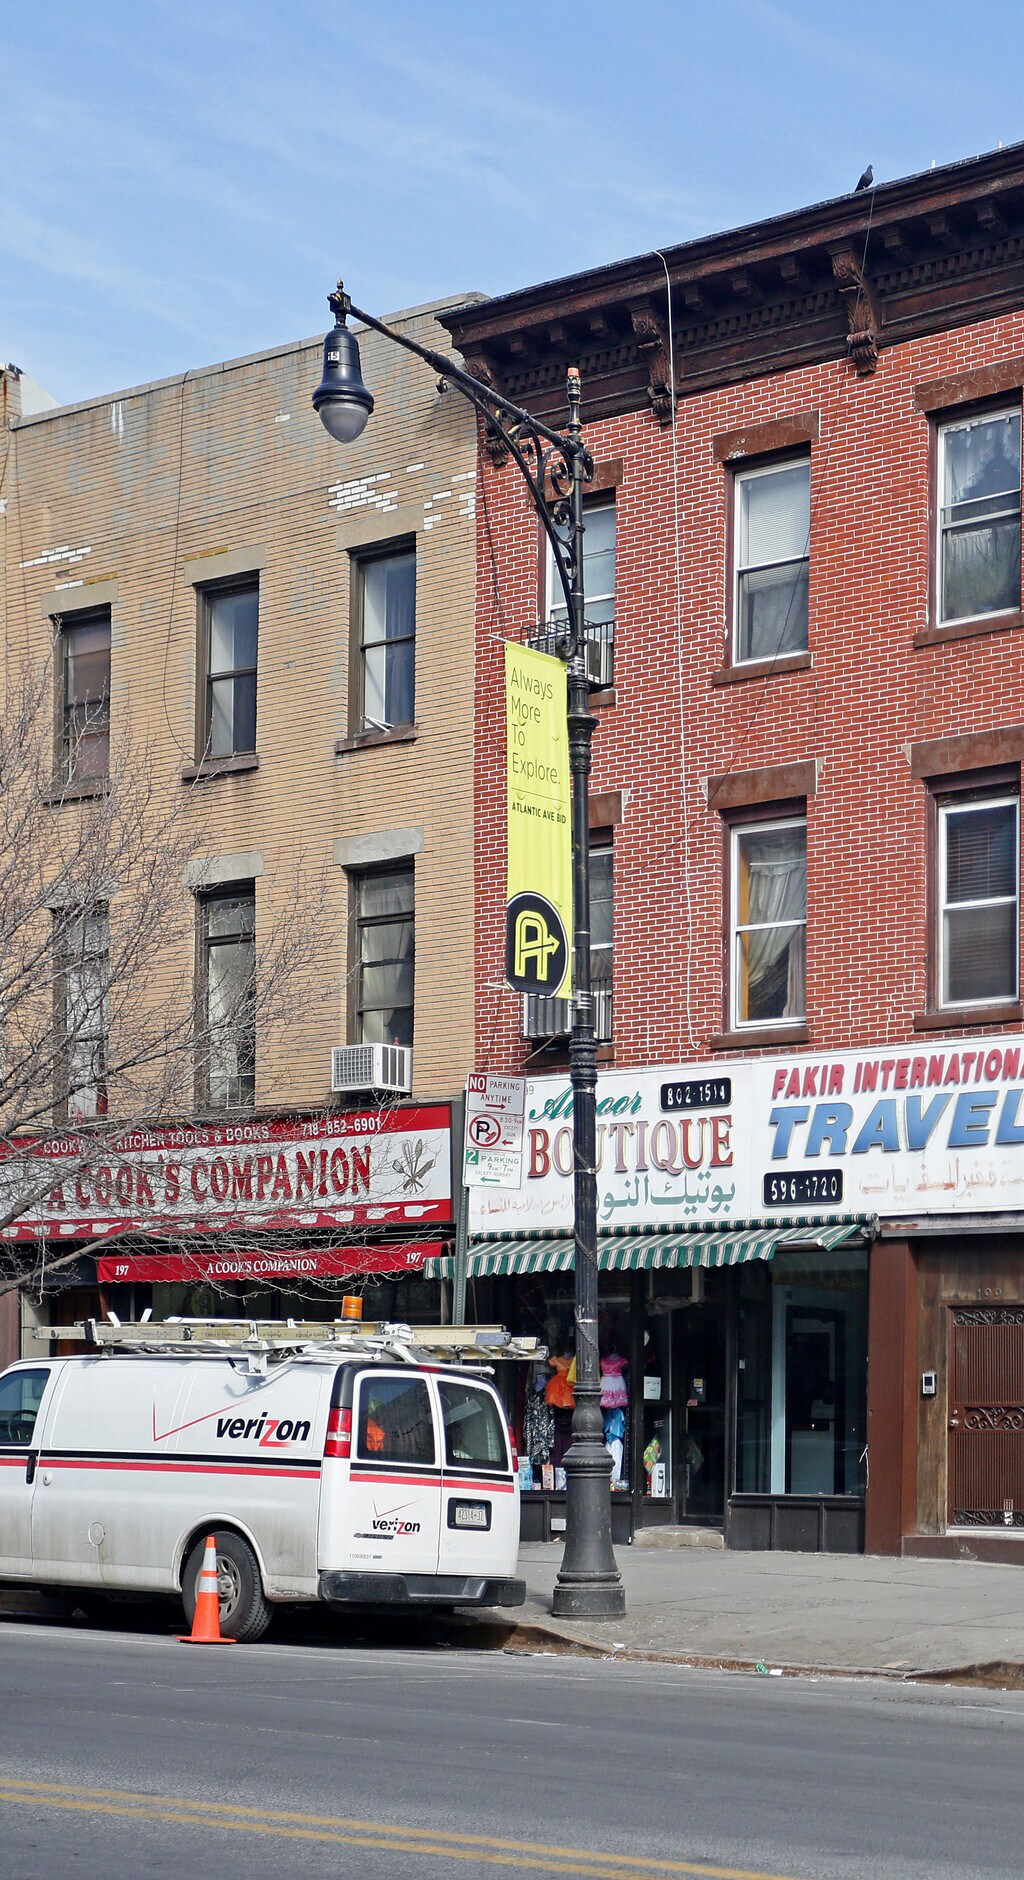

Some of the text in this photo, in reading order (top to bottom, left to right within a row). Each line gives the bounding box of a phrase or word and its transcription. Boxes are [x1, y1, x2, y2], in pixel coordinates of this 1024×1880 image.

[510, 667, 554, 701] Always
[511, 695, 541, 723] More
[511, 724, 526, 746] To
[512, 752, 561, 785] Explore.
[512, 802, 567, 825] ATLANTIC AVE BID
[469, 1076, 486, 1091] NO
[489, 1080, 520, 1091] PARKING
[771, 1063, 845, 1099] FAKIR
[480, 1094, 512, 1104] ANYTIME
[169, 1130, 209, 1146] TOOLS
[226, 1126, 270, 1142] BOOKS
[301, 1116, 382, 1137] 718-852-6901
[467, 1150, 477, 1165] 2
[481, 1155, 519, 1165] PARKING
[189, 1145, 372, 1203] COMPANION
[115, 1264, 130, 1277] 197
[206, 1262, 215, 1274] A
[253, 1258, 318, 1272] COMPANION
[406, 1252, 422, 1264] 197
[976, 1287, 1002, 1301] 199
[216, 1412, 311, 1449] verizon
[372, 1518, 421, 1535] verizon
